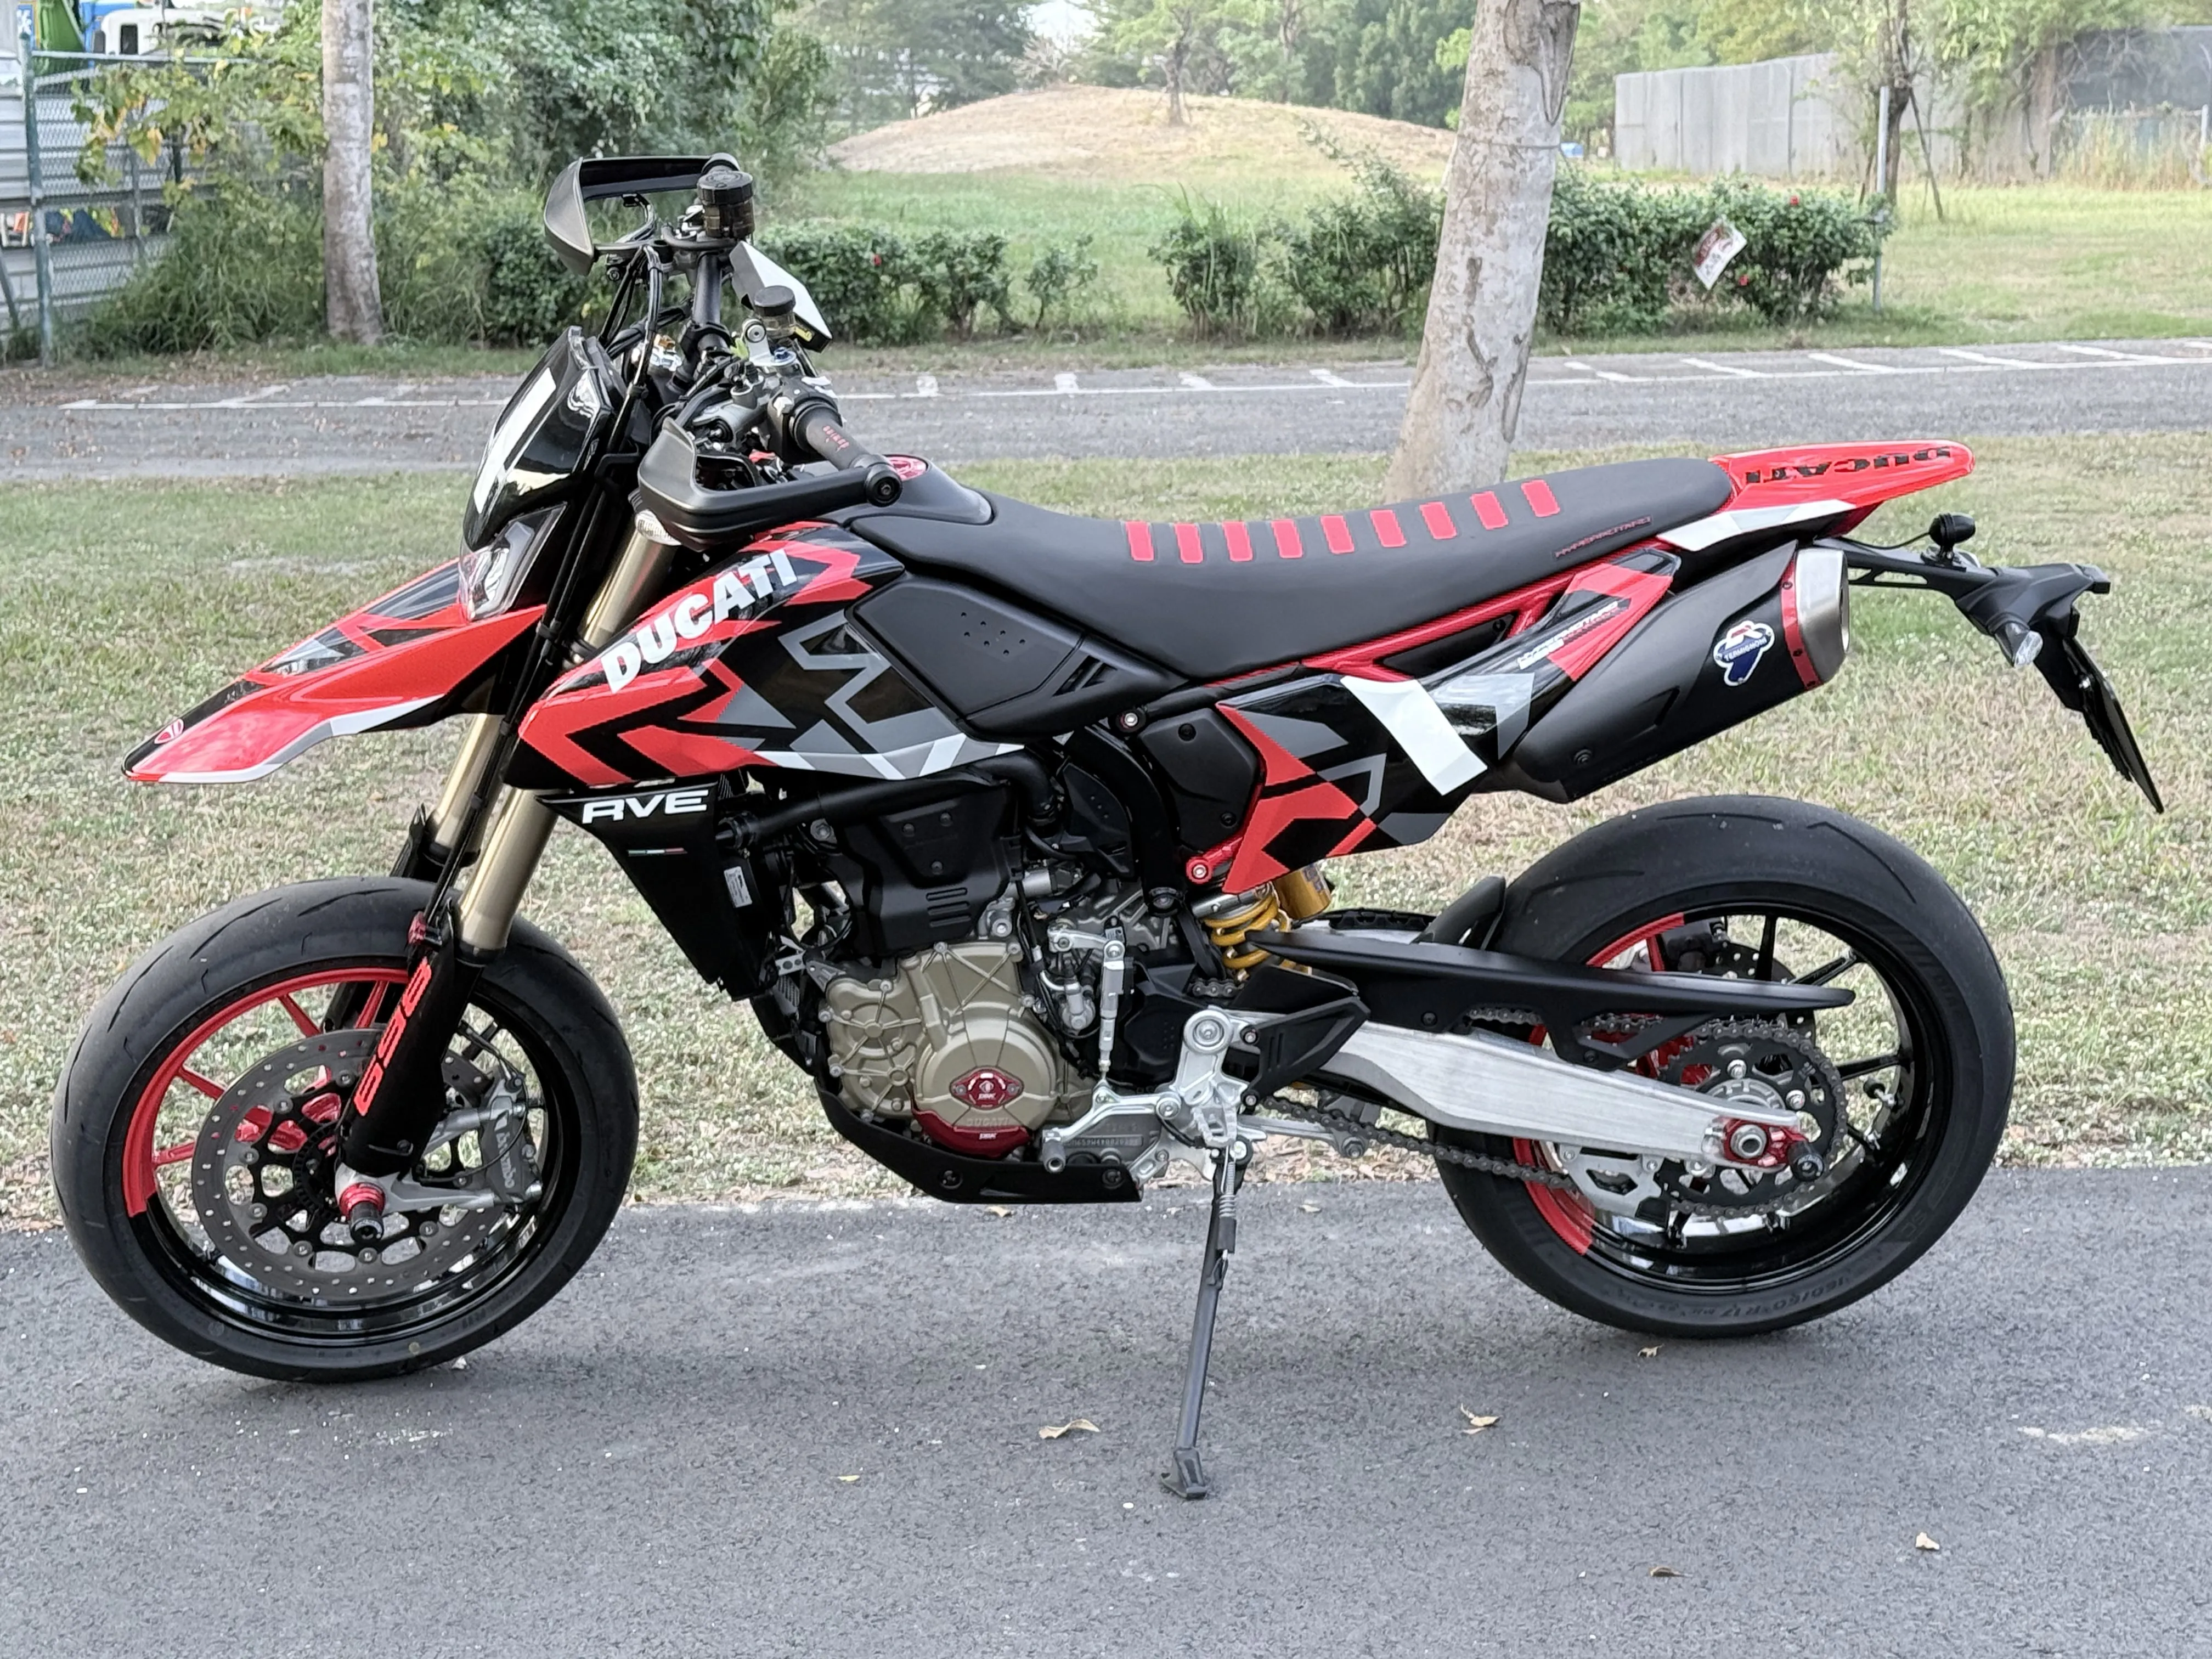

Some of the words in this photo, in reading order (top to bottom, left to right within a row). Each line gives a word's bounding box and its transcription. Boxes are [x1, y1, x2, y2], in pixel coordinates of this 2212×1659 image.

[1745, 445, 1952, 484] DUCATI
[600, 549, 798, 693] DUCATI
[966, 1116, 1010, 1127] DUCATI
